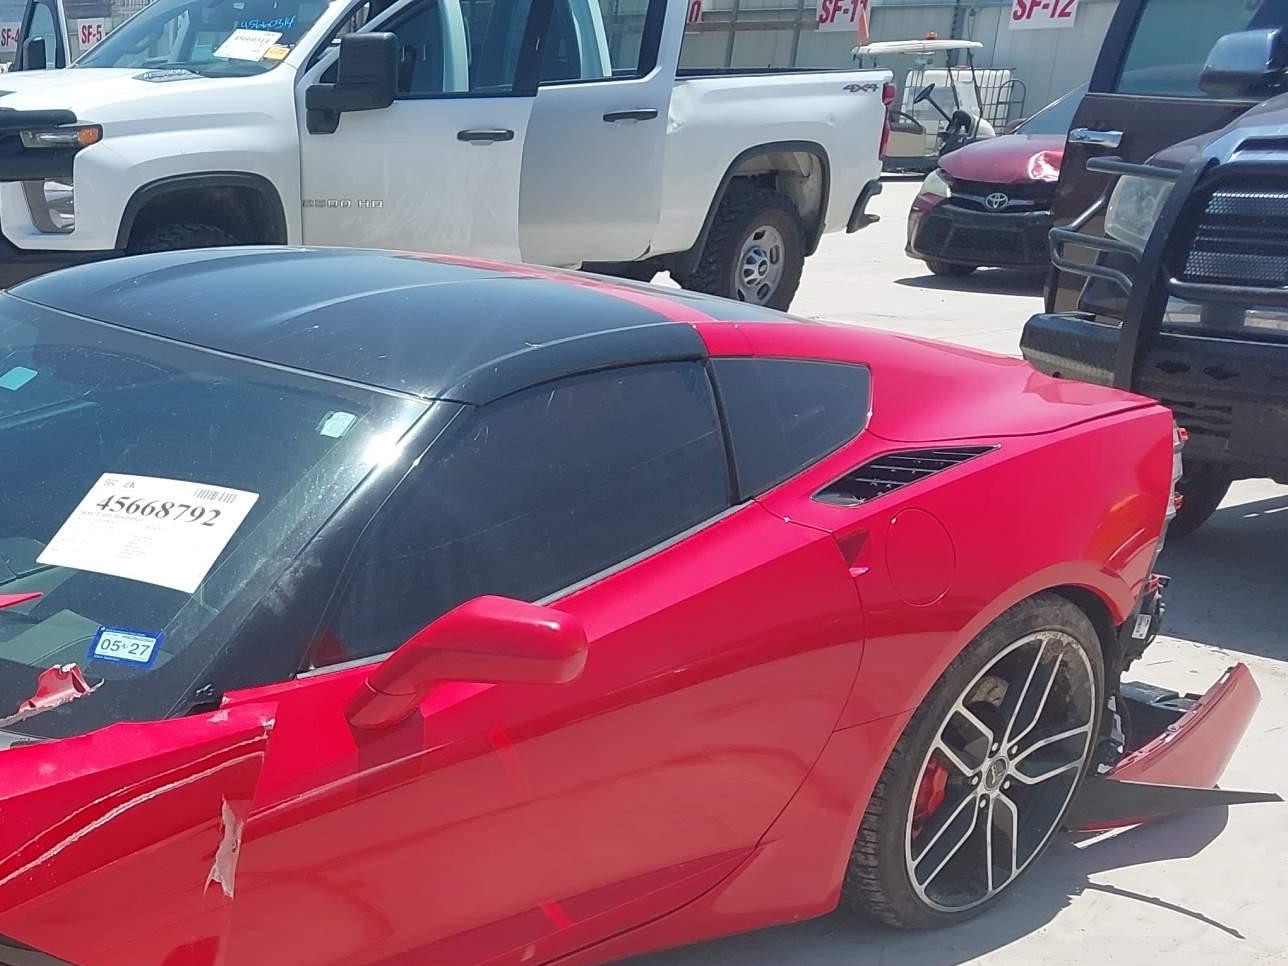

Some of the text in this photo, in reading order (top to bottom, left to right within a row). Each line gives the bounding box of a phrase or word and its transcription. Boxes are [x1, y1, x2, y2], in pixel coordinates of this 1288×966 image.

[1012, 0, 1073, 20] SF-12
[81, 25, 102, 44] SF-5
[357, 199, 384, 209] HD
[96, 494, 222, 527] 45668792
[100, 638, 123, 652] 05
[127, 643, 151, 656] 27
